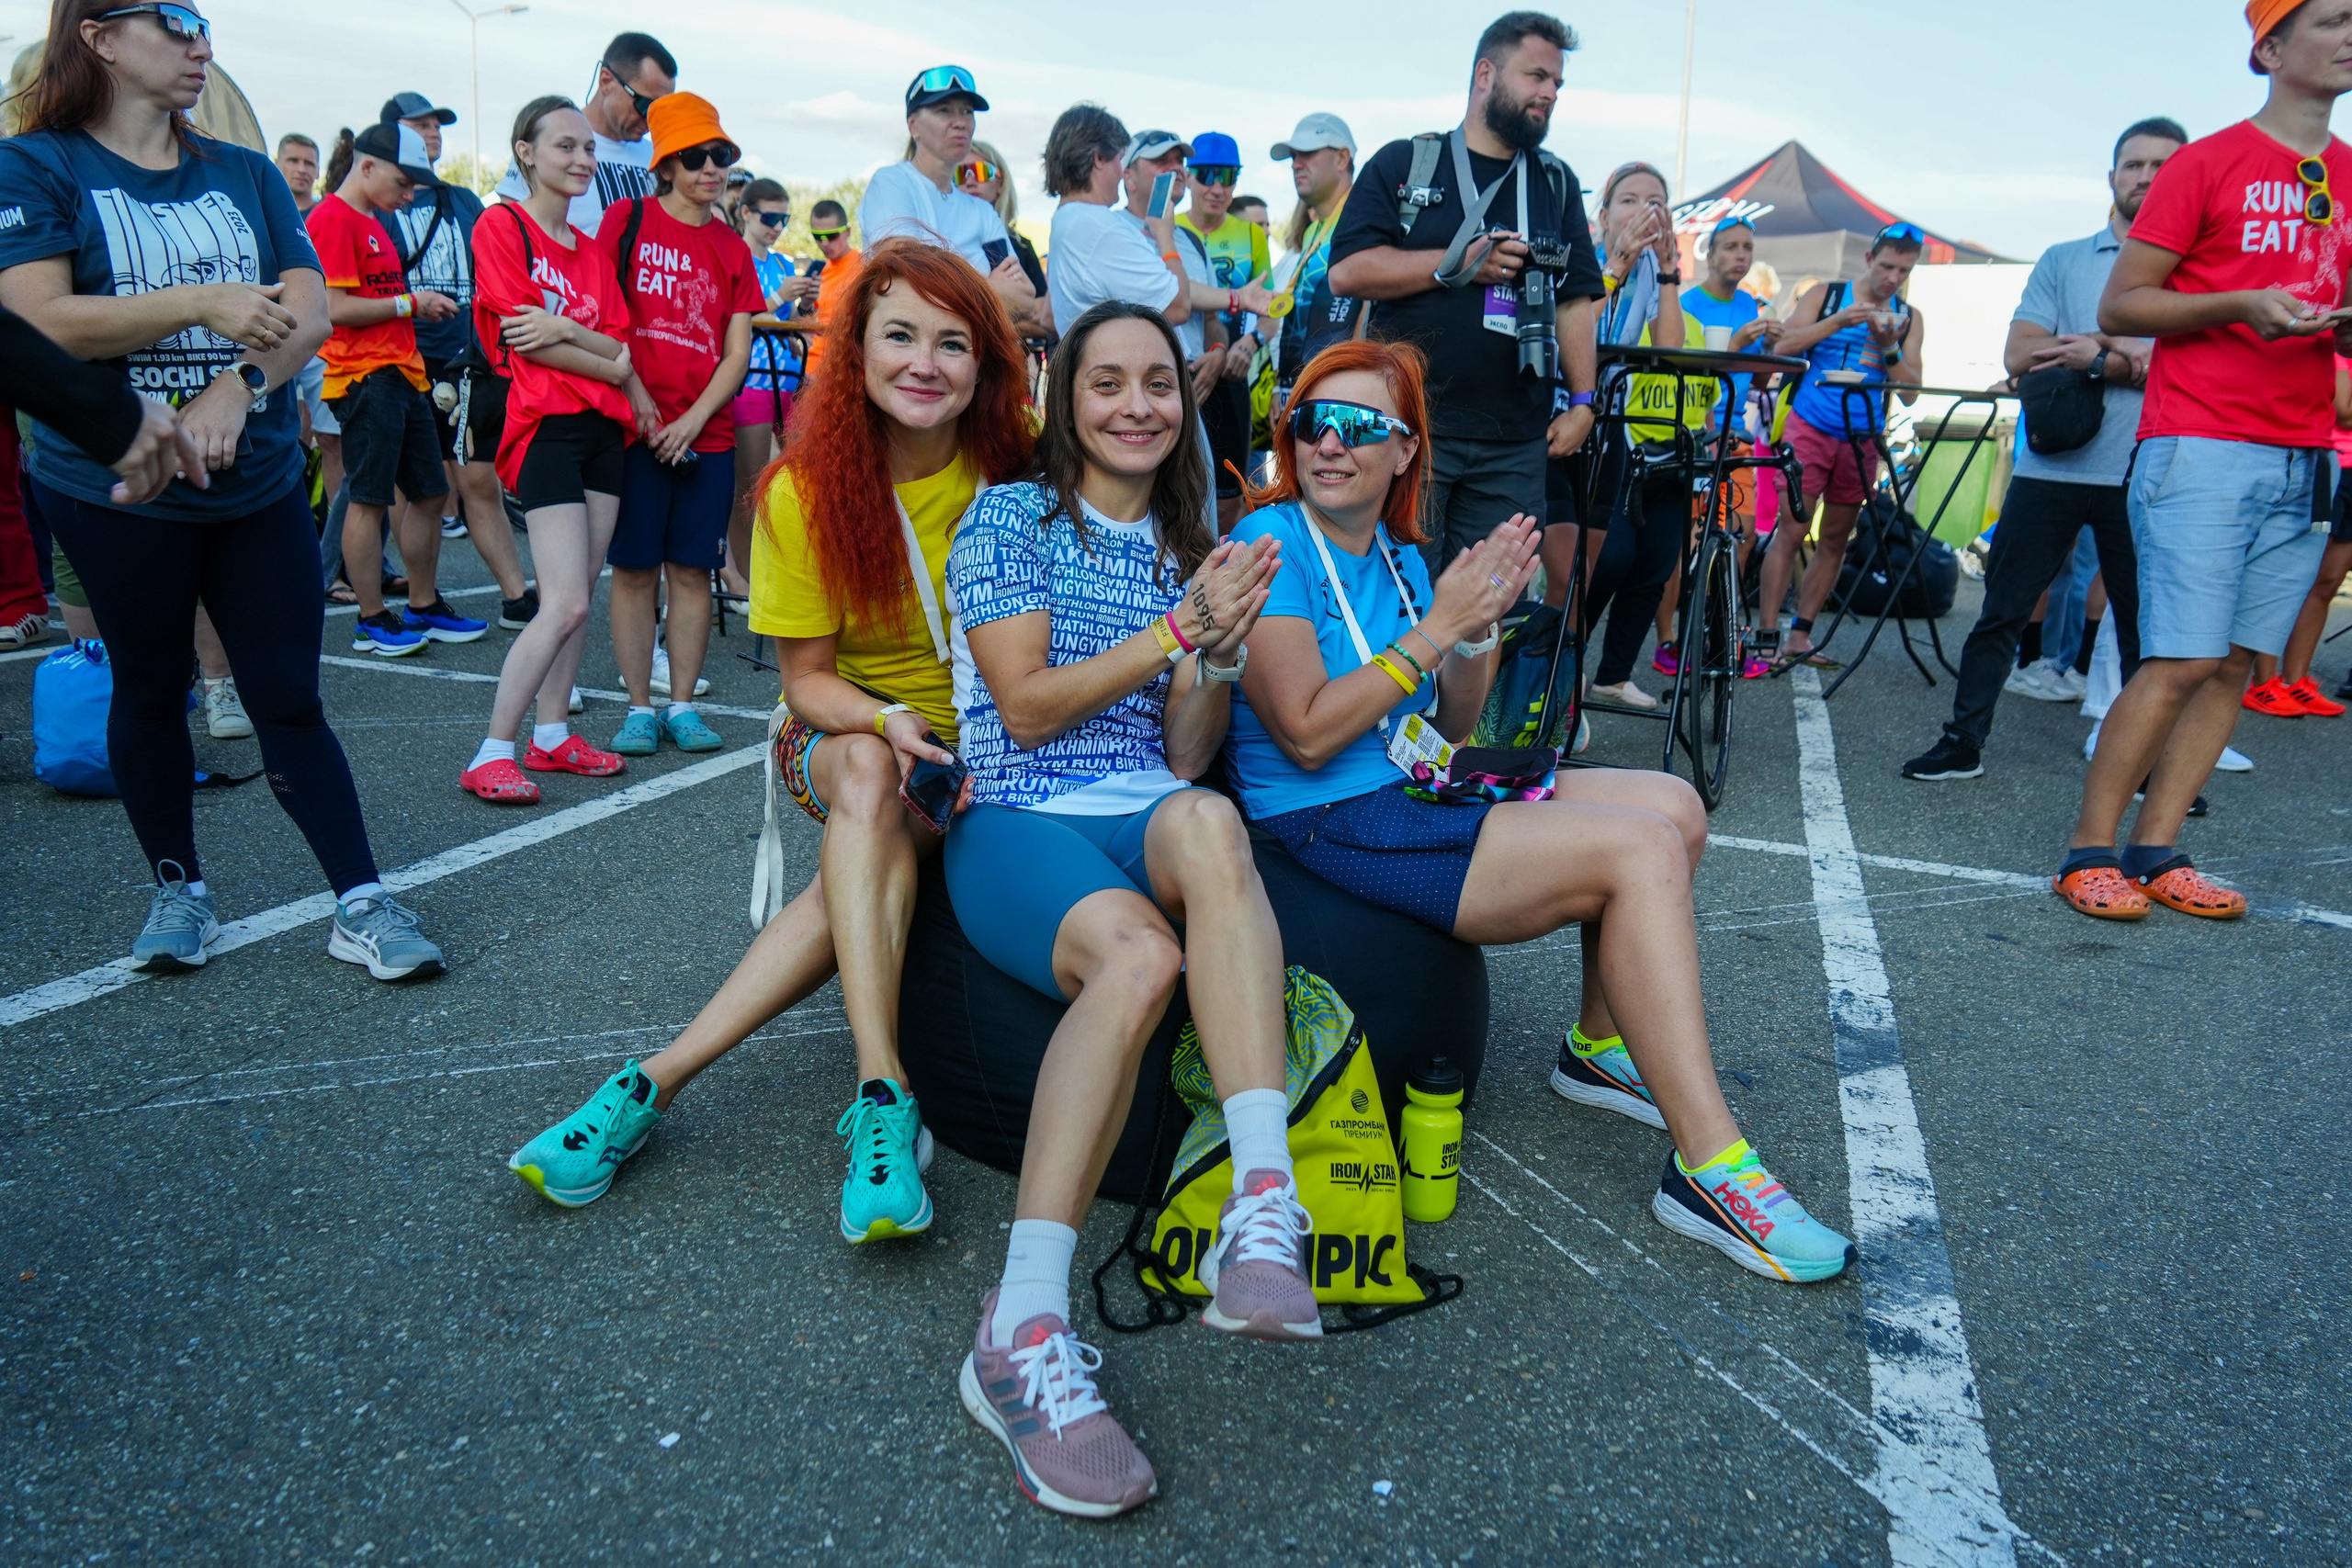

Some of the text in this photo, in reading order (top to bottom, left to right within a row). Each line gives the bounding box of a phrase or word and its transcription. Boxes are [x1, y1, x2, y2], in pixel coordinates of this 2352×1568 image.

[2243, 181, 2303, 216] RUN
[227, 211, 249, 234] 2023
[2242, 219, 2303, 254] EAT
[637, 267, 677, 299] EAT
[127, 354, 151, 362] SWIM
[153, 354, 170, 362] 1.93
[172, 353, 185, 362] km
[187, 353, 206, 361] BIKE
[208, 353, 218, 361] 90
[220, 353, 232, 361] km
[129, 366, 205, 388] SOCHI
[978, 507, 1022, 532] RUN
[976, 535, 996, 546] BIKE
[1109, 530, 1141, 544] RUN
[1100, 546, 1121, 557] RUN
[1130, 549, 1151, 562] BIKE
[994, 582, 1030, 599] IRONMAN
[1065, 580, 1152, 610] GYM SWIM
[1099, 575, 1128, 589] GYM
[1132, 582, 1163, 597] RUN
[1051, 597, 1097, 612] RIATHLON
[1100, 605, 1127, 617] BIKE
[1051, 607, 1125, 626] YM RUN IRONMAN
[1152, 603, 1172, 613] BIKE
[1192, 583, 1215, 631] 1095
[1050, 616, 1114, 638] RIATHLON
[1051, 631, 1078, 653] UN
[984, 708, 999, 718] BIK
[1089, 719, 1152, 739] GYM RUN
[967, 739, 1005, 758] SWIM
[1037, 739, 1108, 758] VAKHMIN
[1001, 752, 1035, 766] IRONMAN
[1071, 759, 1112, 771] RUN
[1115, 756, 1141, 771] BIKE
[1001, 777, 1058, 794] RUN
[1007, 793, 1042, 805] BIKE
[1330, 1120, 1385, 1132] ГАЗПРОМБАНК
[1344, 1130, 1384, 1139] ПРЕМИУМ
[1330, 1163, 1396, 1180] IRON STAR
[1713, 1181, 1775, 1241] HOKA
